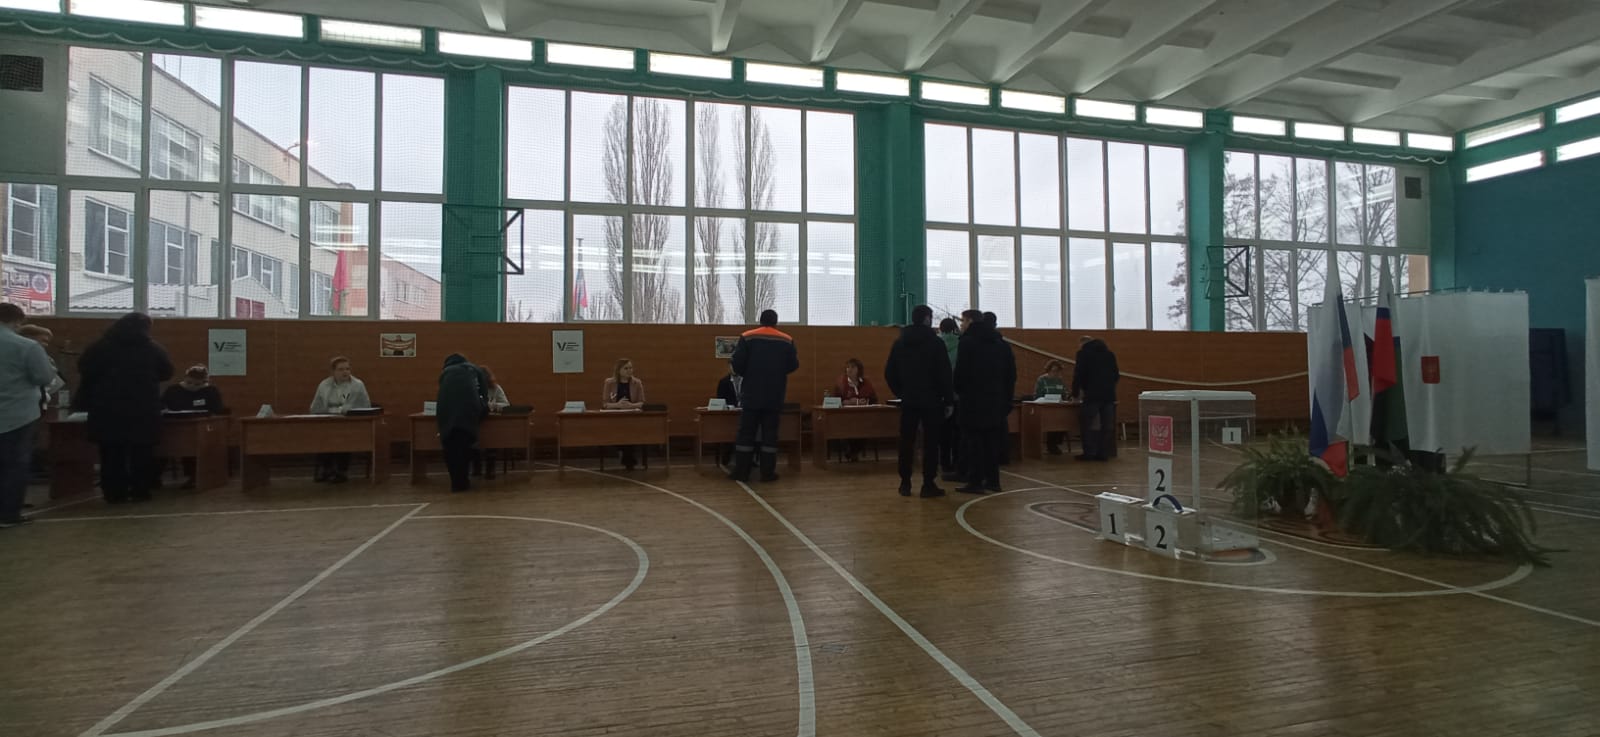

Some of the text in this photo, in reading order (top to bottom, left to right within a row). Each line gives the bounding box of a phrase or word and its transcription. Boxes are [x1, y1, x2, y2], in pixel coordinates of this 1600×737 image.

[1229, 431, 1235, 441] 1
[1155, 469, 1166, 491] 2
[1109, 513, 1118, 535] 1
[1154, 525, 1167, 549] 2
